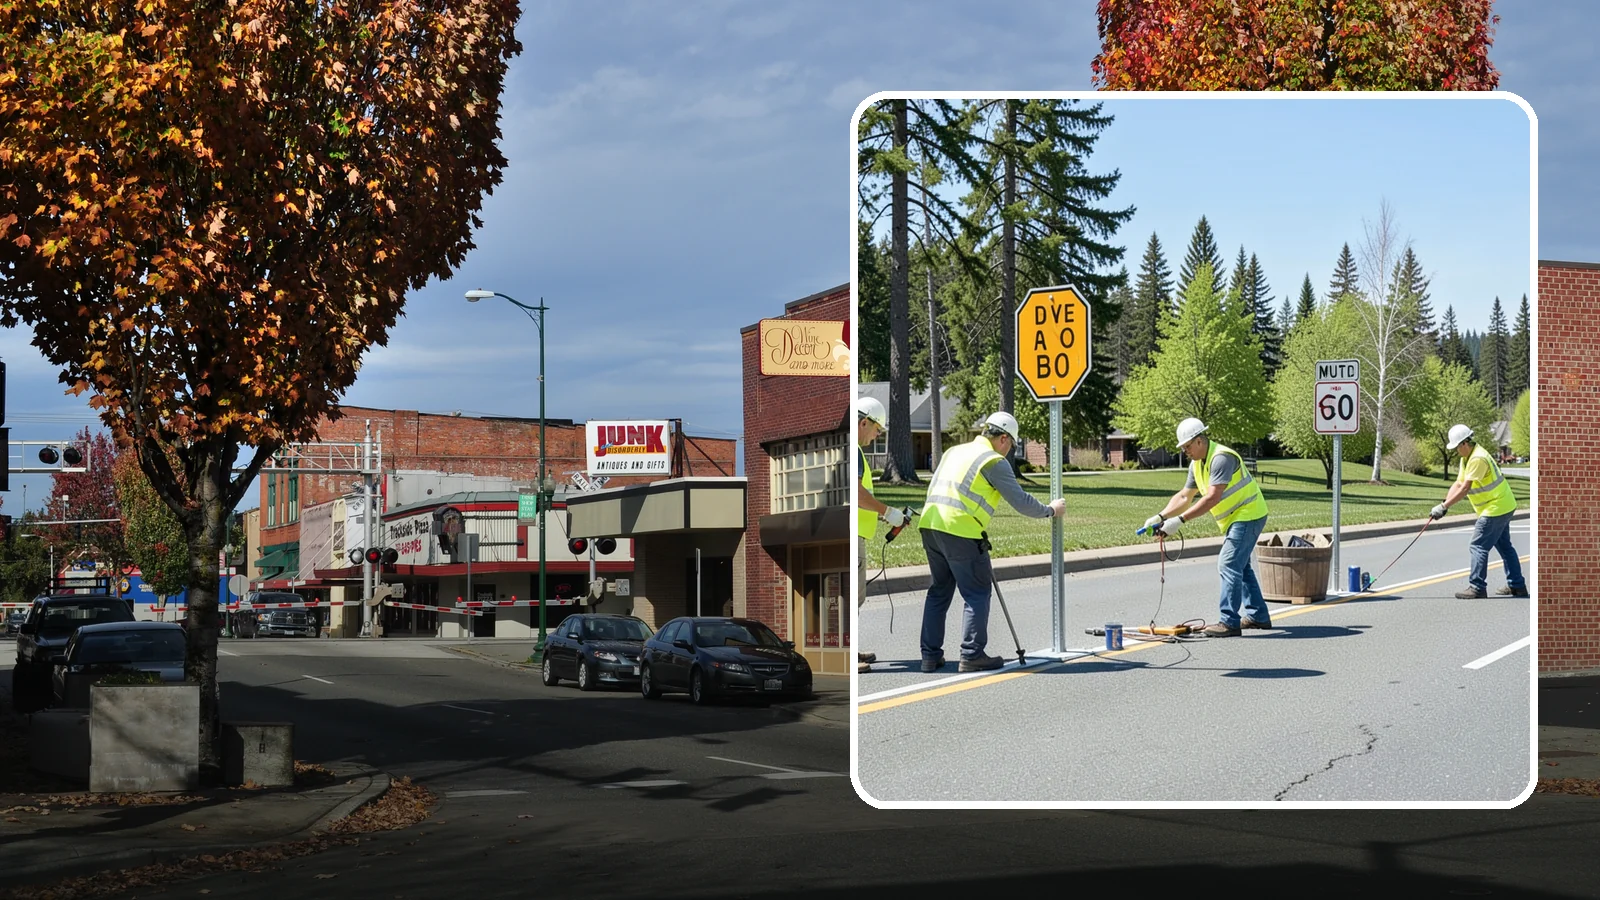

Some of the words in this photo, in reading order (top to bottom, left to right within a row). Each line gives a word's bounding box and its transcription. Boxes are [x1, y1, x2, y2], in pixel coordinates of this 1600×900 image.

[596, 425, 665, 457] JUNK
[607, 445, 645, 454] DISORDERLY
[597, 461, 628, 470] ANTIQUES
[631, 461, 644, 470] AND
[647, 460, 665, 470] GIFTS
